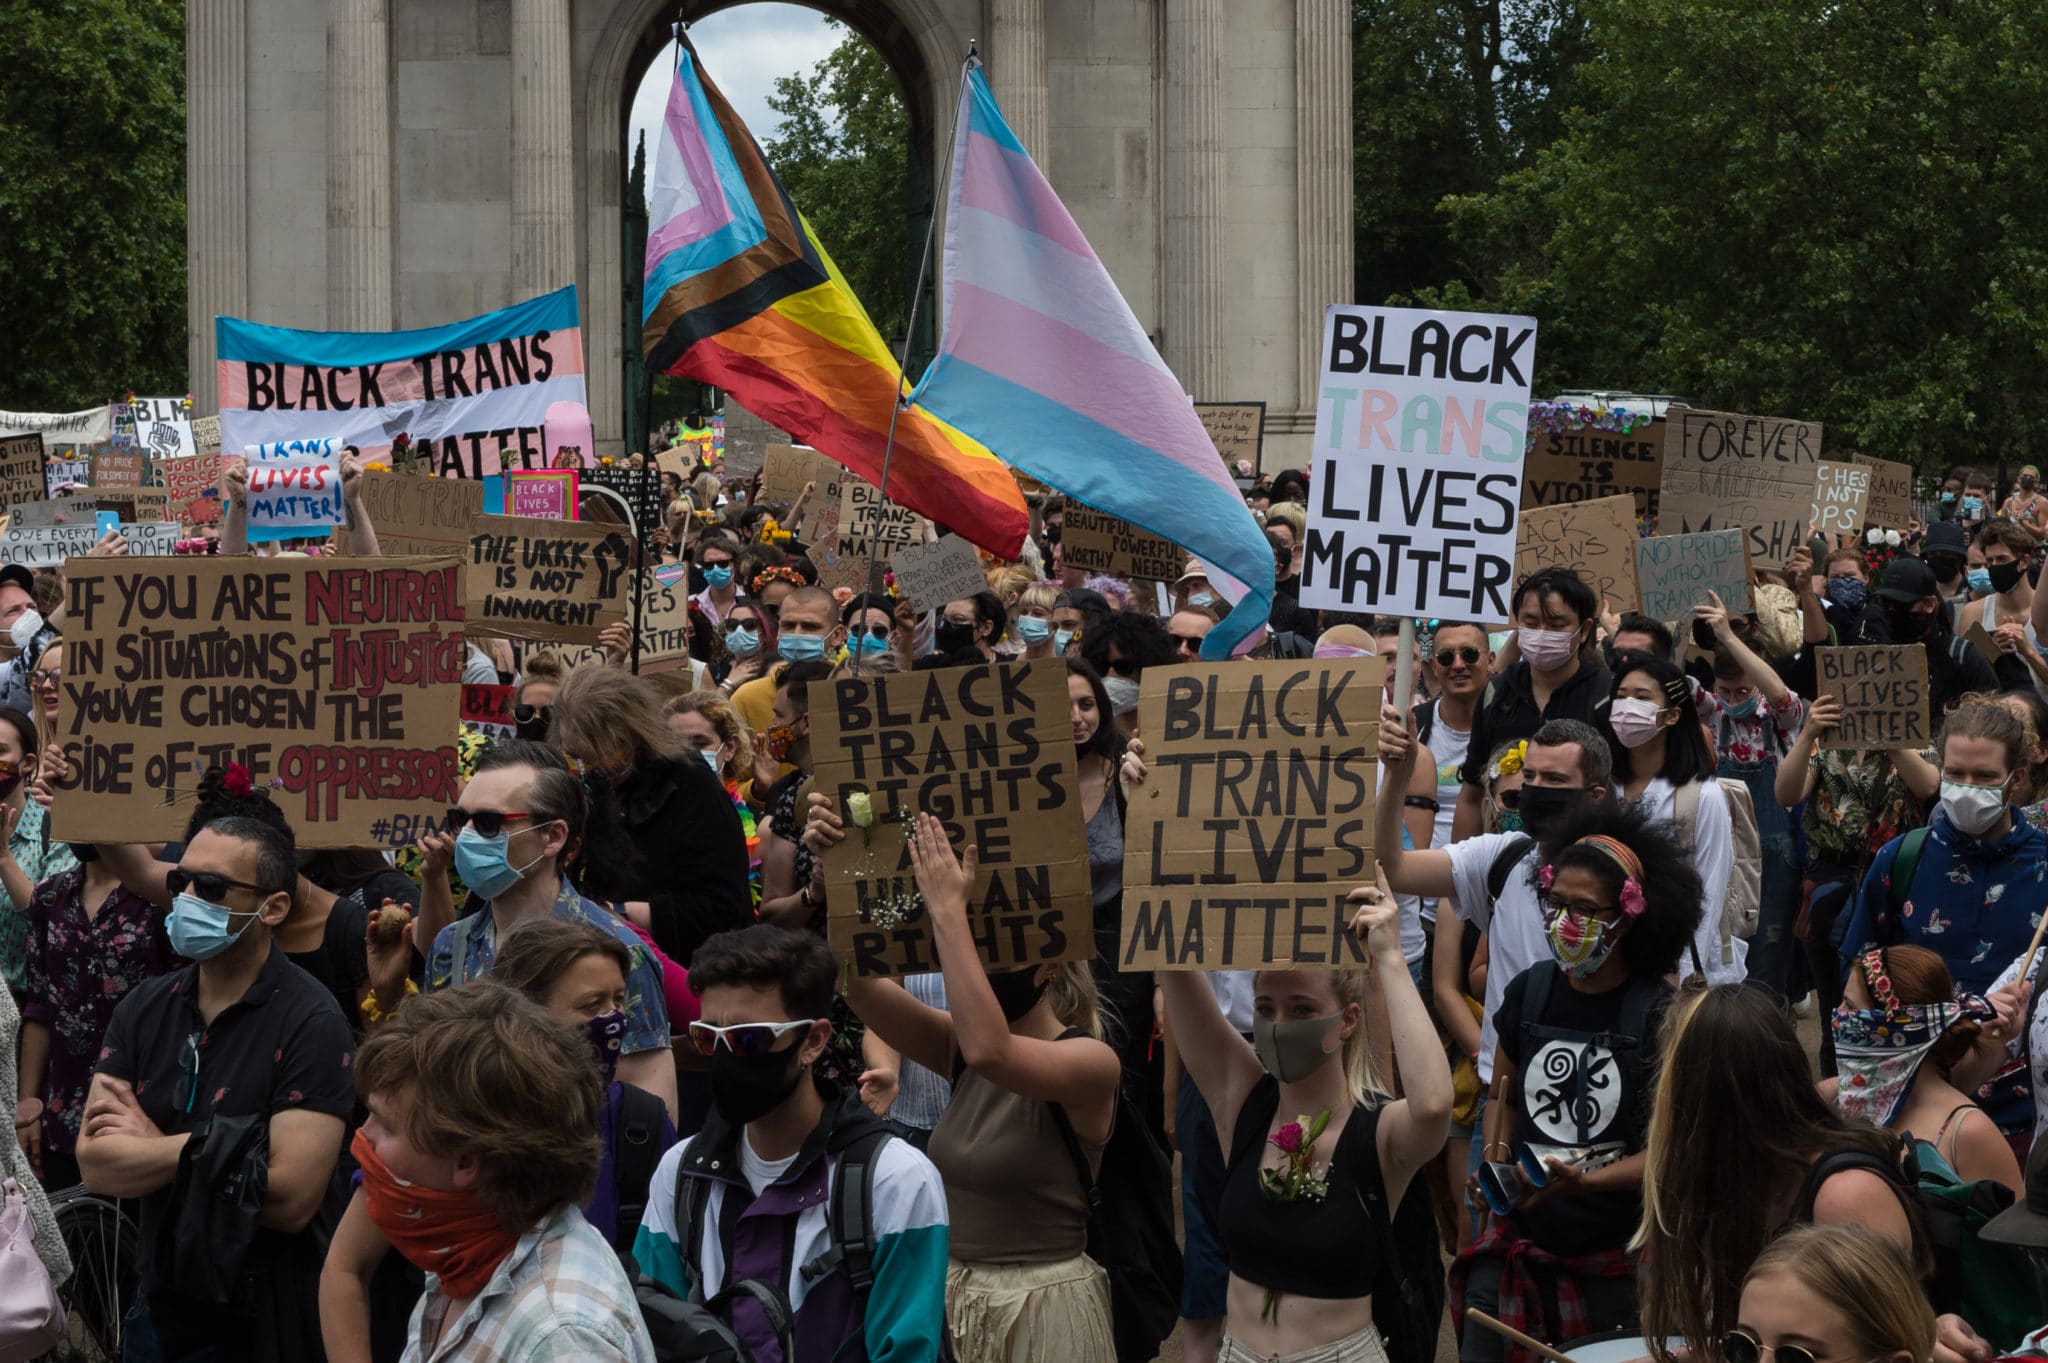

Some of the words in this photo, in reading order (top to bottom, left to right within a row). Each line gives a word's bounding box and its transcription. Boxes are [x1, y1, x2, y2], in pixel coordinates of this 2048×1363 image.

[1330, 314, 1534, 387] BLACK
[245, 360, 385, 411] BLACK
[412, 330, 555, 401] TRANS
[5, 414, 45, 431] LIVES
[137, 400, 191, 421] BLM
[1323, 387, 1526, 463] TRANS
[12, 441, 39, 455] LIVES
[1546, 434, 1655, 462] SILENCE
[1683, 414, 1814, 463] FOREVER
[250, 464, 330, 493] LIVES
[1579, 461, 1614, 483] IS
[1667, 461, 1795, 499] GRATEFUL
[1817, 466, 1868, 487] CHES
[1869, 474, 1908, 498] RANS
[252, 481, 341, 523] MATTER!
[516, 483, 554, 496] BLACK
[516, 498, 550, 510] LIVES
[1322, 460, 1517, 535] LIVES
[1817, 485, 1865, 505] INST
[854, 506, 916, 525] TRANS
[1720, 500, 1758, 522] TO
[9, 529, 42, 542] OWE
[138, 526, 155, 538] TO
[850, 521, 912, 541] LIVES
[1517, 515, 1592, 546] ACK
[0, 545, 37, 563] ACK
[43, 541, 95, 561] TRAN
[128, 537, 178, 556] OMEN
[470, 533, 518, 564] THE
[522, 537, 589, 570] UKKK
[1062, 544, 1114, 569] WORTHY
[1131, 558, 1183, 579] NEEDED
[1112, 535, 1182, 561] POWERFUL
[1516, 537, 1609, 569] TRANS
[1640, 540, 1671, 569] NO
[1681, 533, 1743, 561] PRIDE
[495, 566, 517, 588] IS
[530, 570, 584, 594] NOT
[1302, 529, 1511, 617] MATTER
[1652, 560, 1728, 587] WITHOUT
[67, 575, 104, 631] IF
[114, 573, 197, 627] YOU
[211, 573, 291, 621] ARE
[305, 567, 466, 625] NEUTRAL
[926, 575, 969, 607] MATTER
[483, 594, 603, 625] INNOCENT
[69, 637, 103, 677] IN
[1823, 650, 1904, 679] BLACK
[466, 688, 510, 717] BLA
[835, 662, 1035, 731] BLACK
[1163, 670, 1356, 742] BLACK
[1842, 680, 1919, 707] LIVES
[180, 684, 316, 730] CHOSEN
[324, 694, 405, 742] THE
[840, 718, 1040, 779] TRANS
[278, 746, 459, 822] OPPRESSOR
[1156, 745, 1366, 818] TRANS
[1151, 817, 1365, 886] LIVES
[853, 910, 1067, 977] RIHTS
[1124, 894, 1367, 965] MATTER
